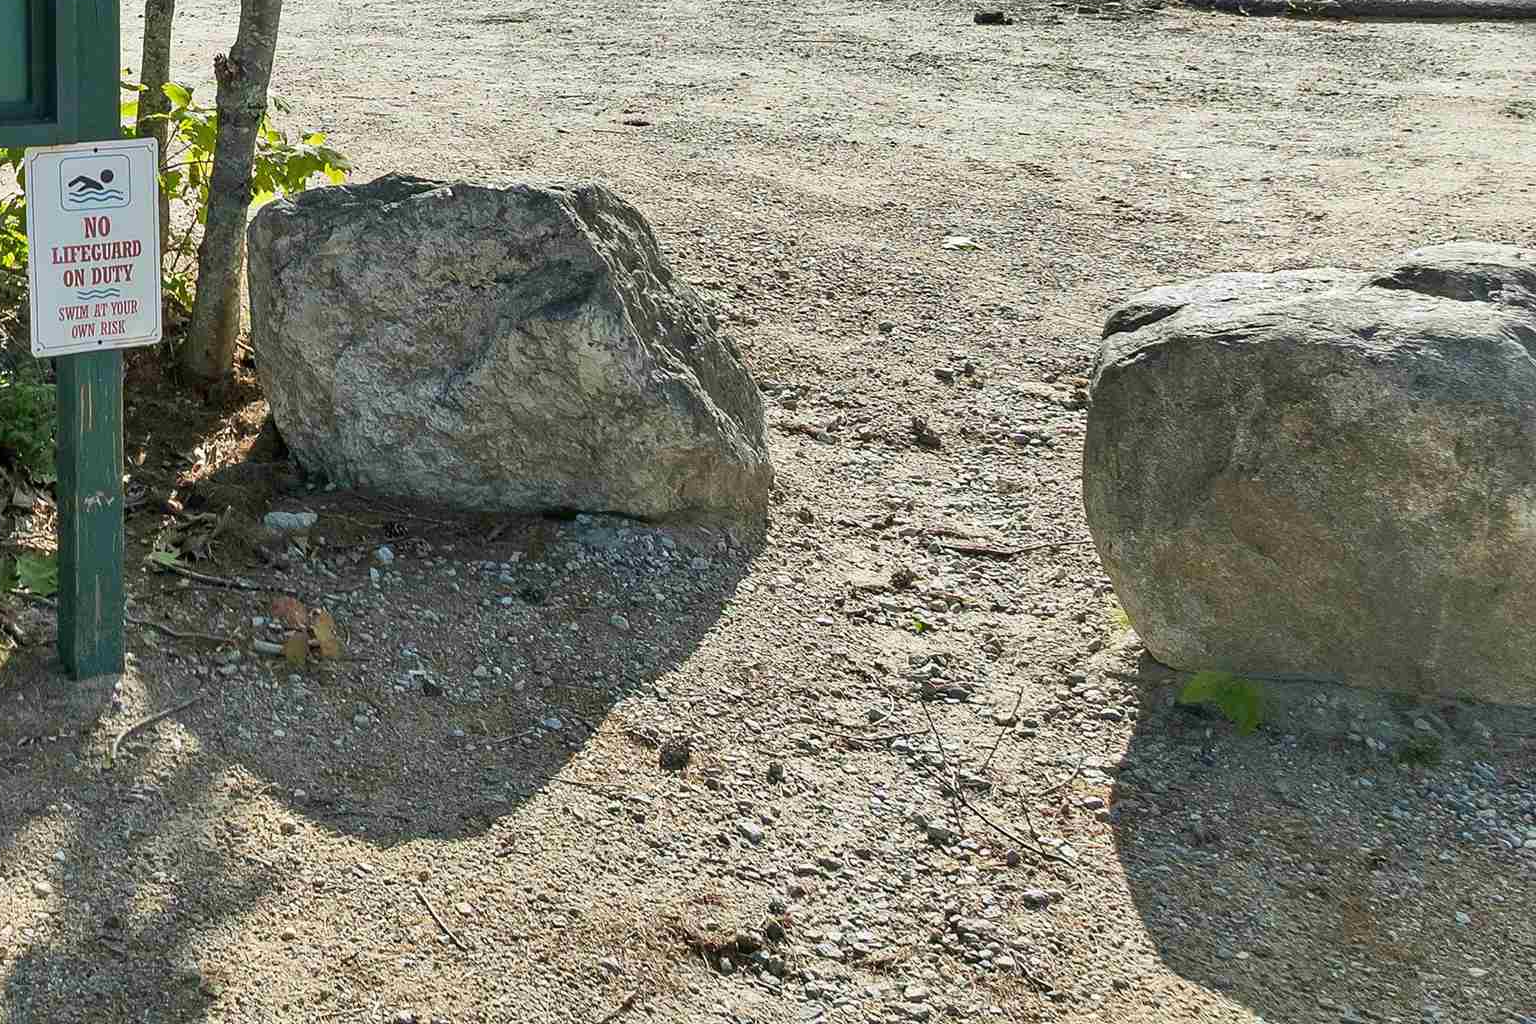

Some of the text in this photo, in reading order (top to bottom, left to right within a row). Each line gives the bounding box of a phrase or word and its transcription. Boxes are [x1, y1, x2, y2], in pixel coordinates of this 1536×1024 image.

[84, 216, 112, 238] NO
[51, 240, 142, 265] LIFEGUARD
[63, 264, 134, 288] ON DUTY
[58, 300, 138, 322] SWIM AT YOUR
[71, 320, 126, 339] OWN RISK
